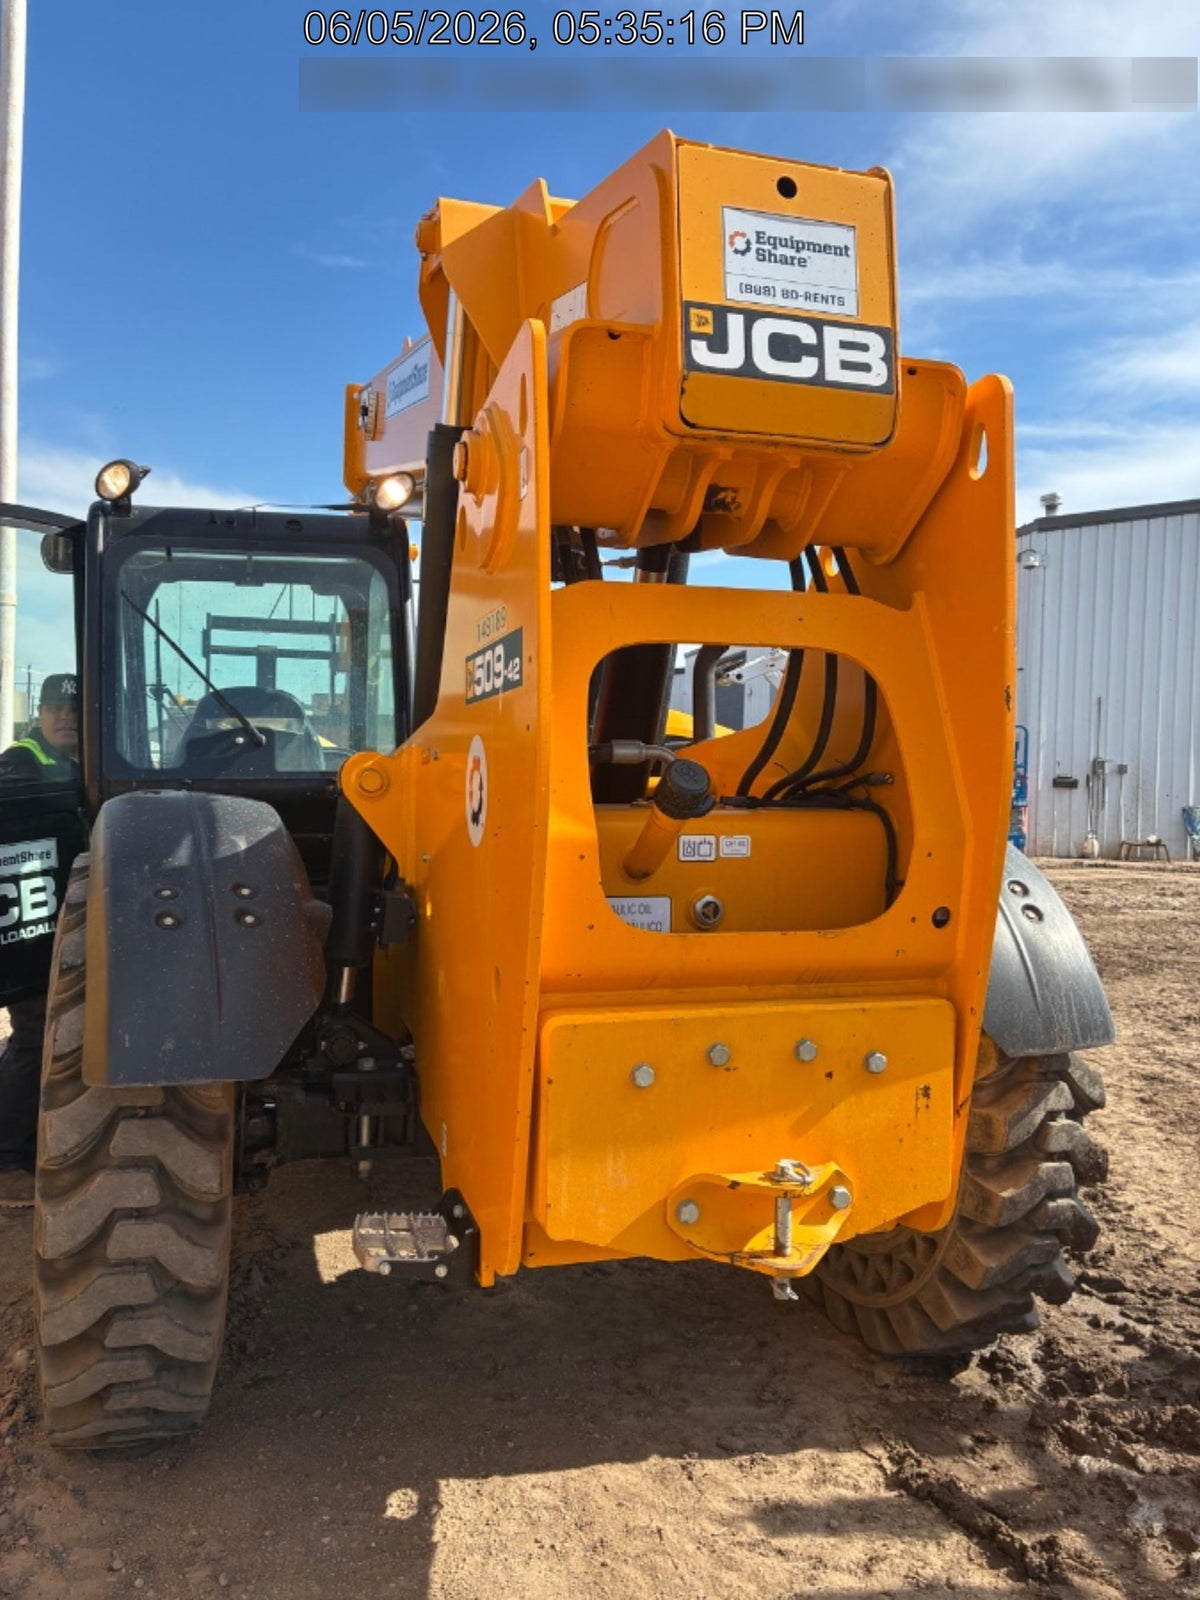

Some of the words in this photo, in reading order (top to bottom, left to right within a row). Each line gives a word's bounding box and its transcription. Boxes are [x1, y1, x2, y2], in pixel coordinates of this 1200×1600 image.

[755, 231, 851, 258] Equipment
[755, 248, 808, 268] Share
[690, 312, 889, 387] JCB
